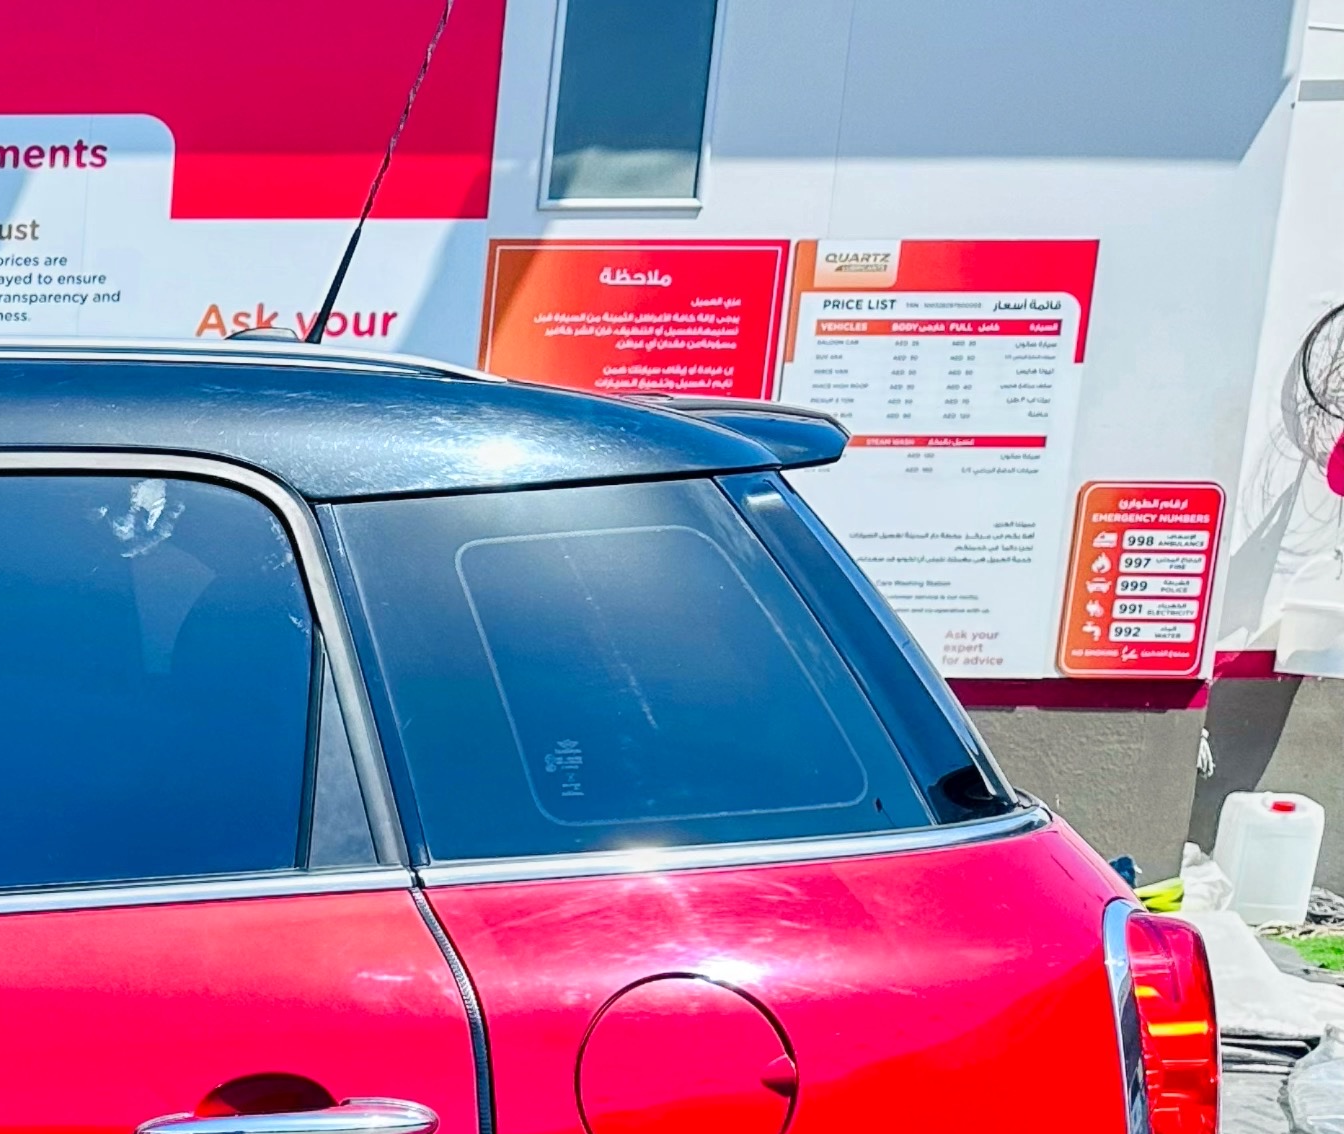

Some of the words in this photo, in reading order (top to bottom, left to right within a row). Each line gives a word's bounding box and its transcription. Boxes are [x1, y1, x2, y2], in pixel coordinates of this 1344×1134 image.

[43, 255, 69, 267] are
[824, 252, 892, 264] QUARTZ
[37, 274, 53, 285] to
[56, 274, 108, 285] ensure
[598, 266, 673, 288] ملاحظة
[91, 290, 122, 303] and
[822, 299, 863, 311] PRICE
[867, 299, 897, 311] LIST
[195, 302, 280, 338] Ask
[820, 322, 869, 332] VEHICLES
[891, 322, 919, 332] BODY
[948, 322, 973, 332] FULL
[1091, 513, 1158, 524] EMERGENCY
[1159, 513, 1211, 524] NUMBERS
[1127, 535, 1155, 547] 998
[1124, 557, 1152, 569] 997
[1120, 580, 1148, 592] 999
[1118, 603, 1143, 614] 991
[944, 629, 968, 640] Ask
[971, 631, 1000, 641] your
[1113, 626, 1141, 638] 992
[943, 642, 984, 653] expert
[941, 654, 960, 666] for
[962, 655, 1004, 667] advice
